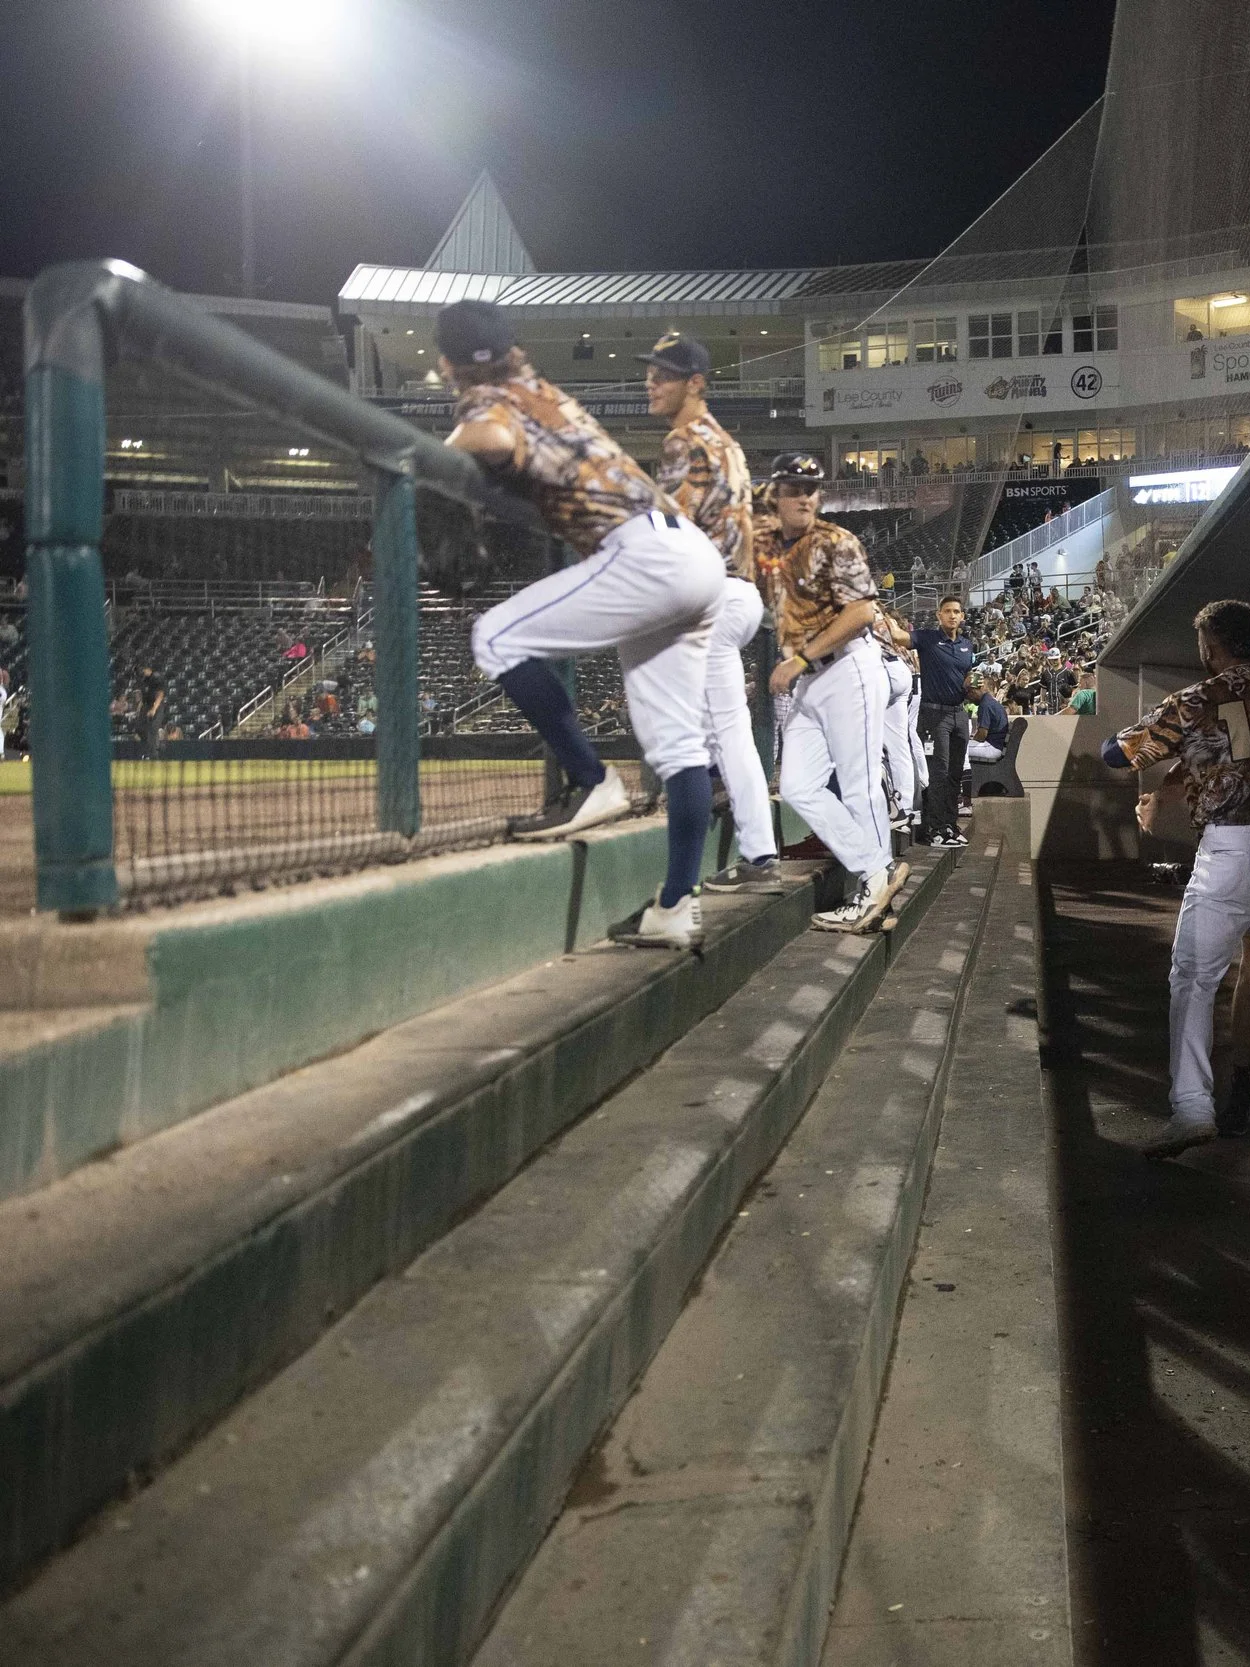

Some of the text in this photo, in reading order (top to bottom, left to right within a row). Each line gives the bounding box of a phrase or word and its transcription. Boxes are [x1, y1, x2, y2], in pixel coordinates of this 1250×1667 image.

[1076, 373, 1098, 391] 42
[838, 389, 903, 403] Lee County
[927, 383, 962, 402] Twins
[1006, 485, 1067, 498] BSN SPORTS
